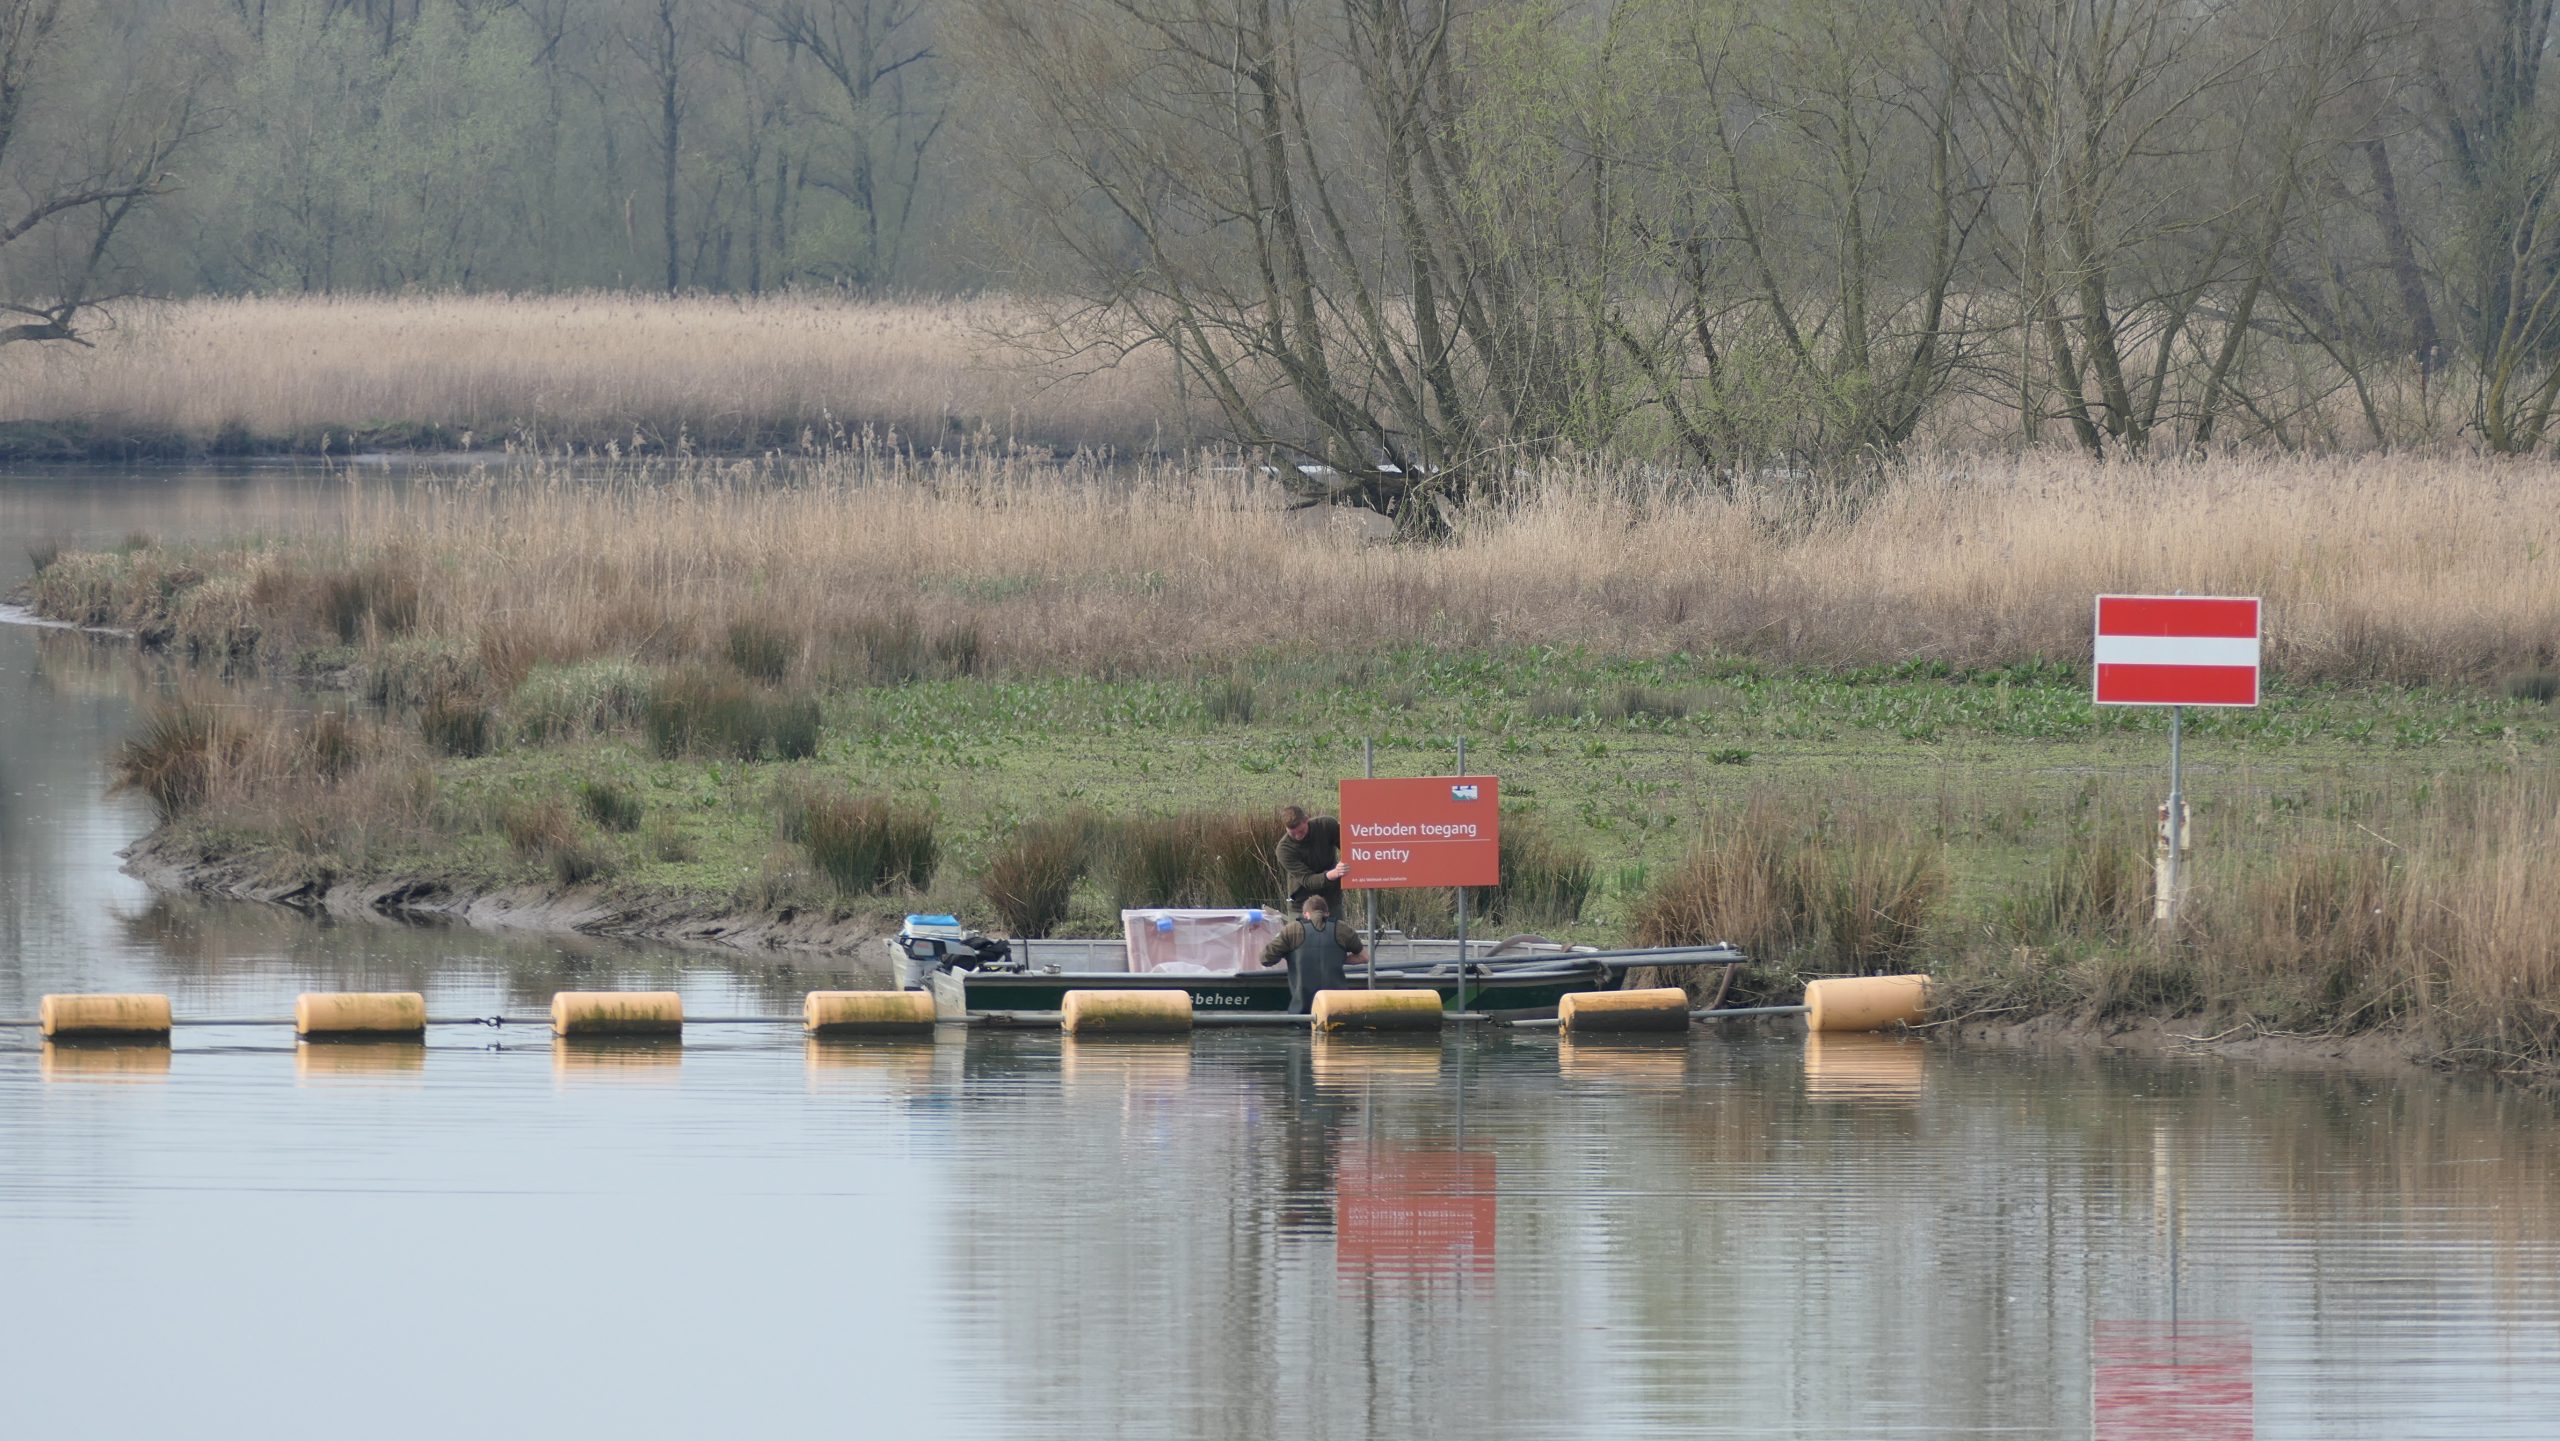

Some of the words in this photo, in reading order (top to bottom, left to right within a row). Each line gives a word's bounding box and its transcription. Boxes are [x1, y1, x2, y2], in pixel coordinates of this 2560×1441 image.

[1350, 823, 1416, 836] Verboden
[1420, 823, 1476, 837] toegang
[1352, 848, 1371, 860] No
[1375, 848, 1409, 862] entry
